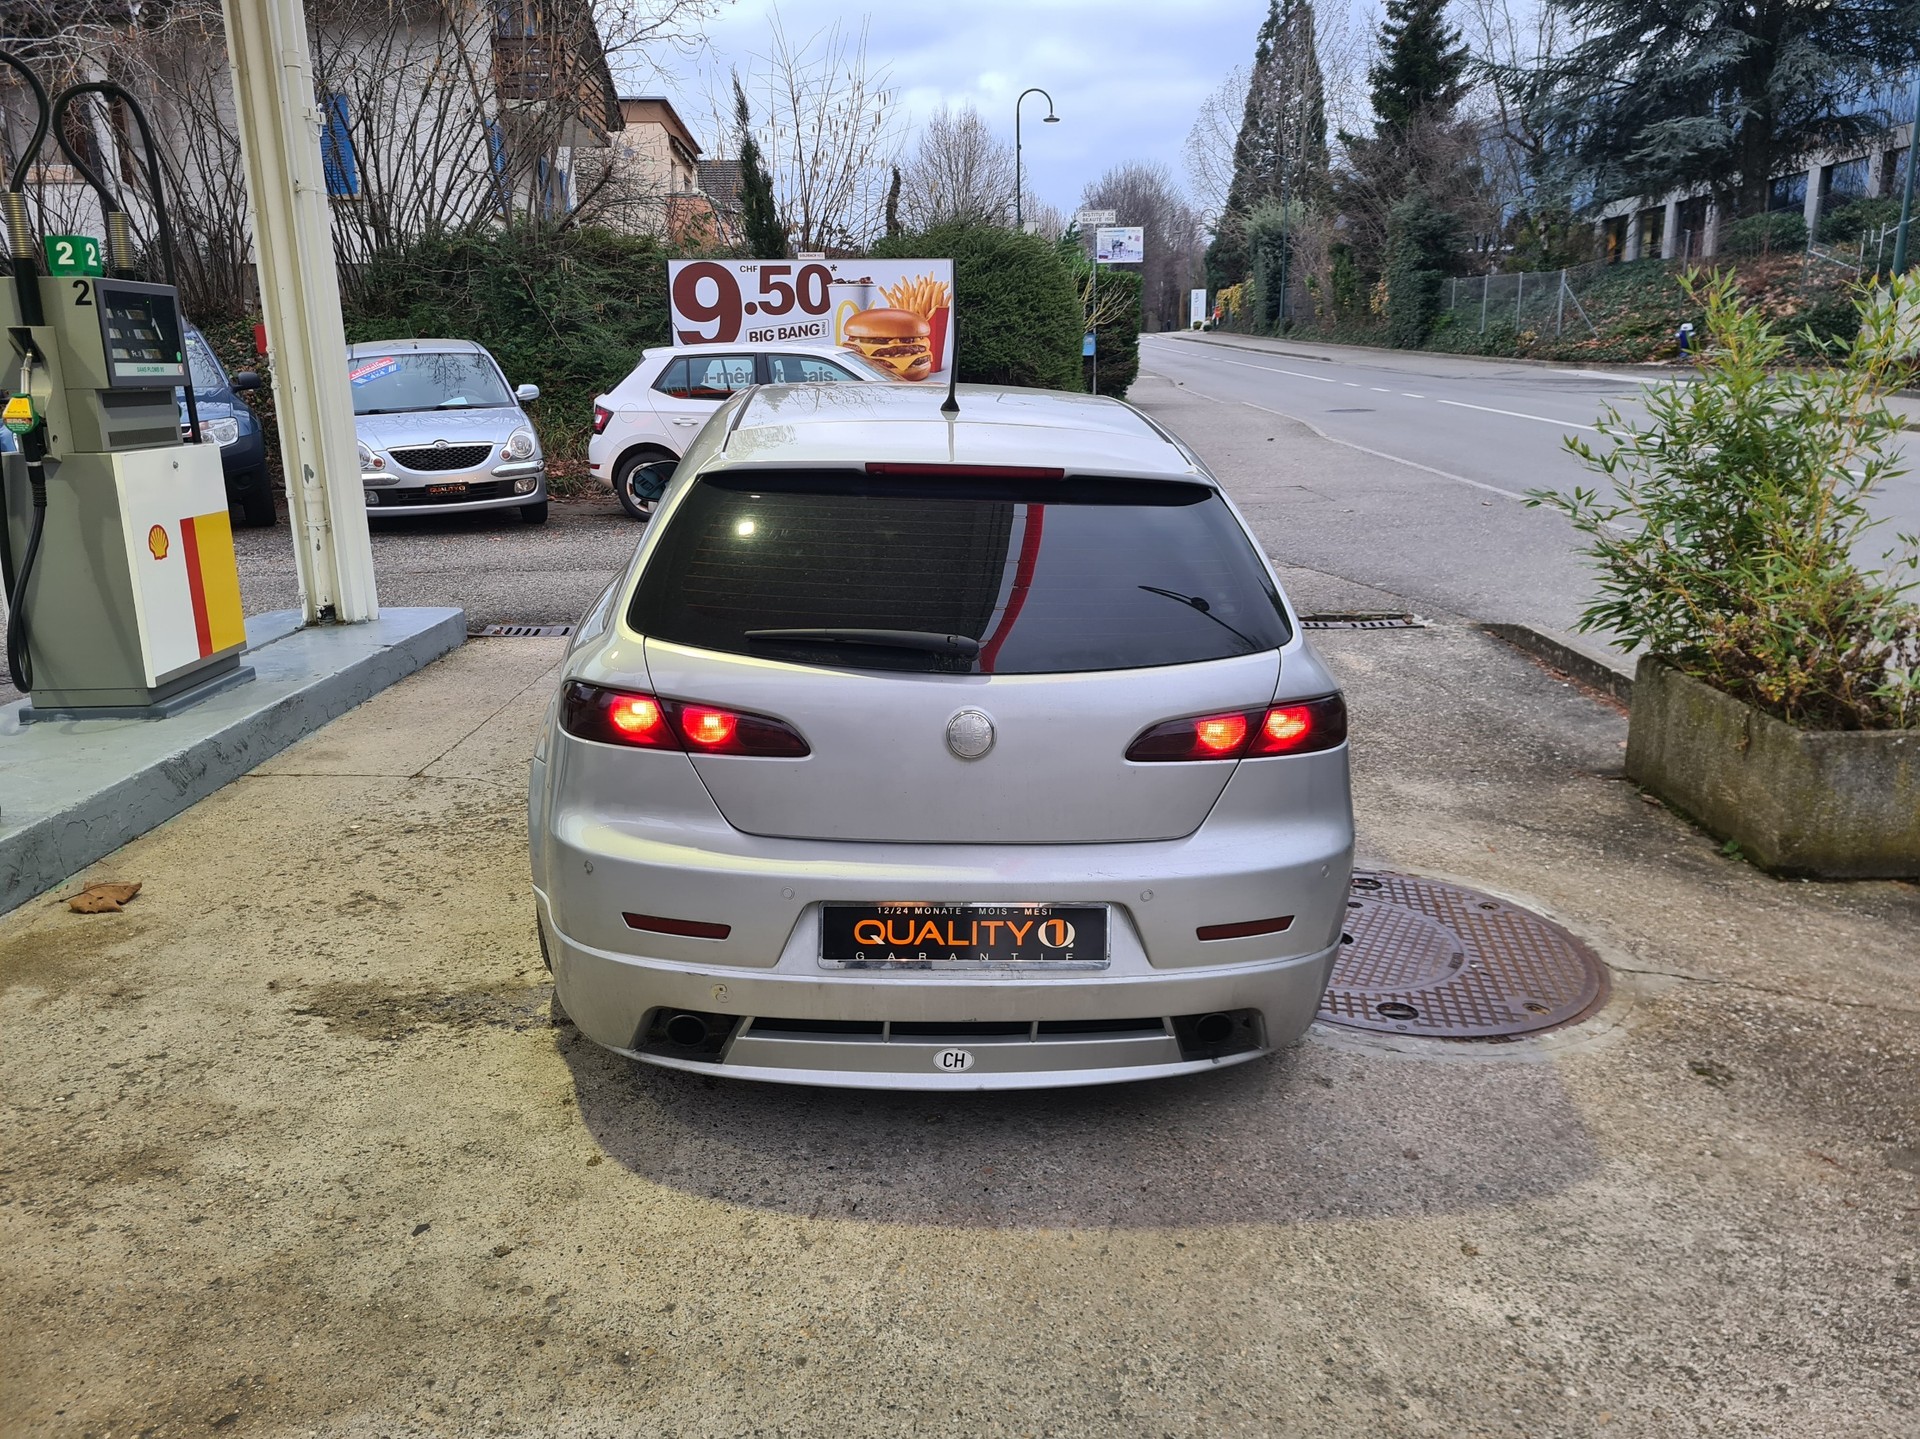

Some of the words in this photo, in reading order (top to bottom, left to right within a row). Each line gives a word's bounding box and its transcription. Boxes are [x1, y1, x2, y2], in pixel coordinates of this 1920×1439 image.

[56, 241, 75, 265] 2
[85, 242, 98, 267] 2
[740, 265, 758, 273] CHF
[72, 279, 93, 306] 2
[749, 329, 775, 342] BIG
[778, 323, 820, 340] BANG
[914, 907, 962, 915] MONATE
[978, 907, 1008, 915] MOIS
[854, 919, 1034, 946] QUALITY
[943, 1052, 965, 1068] CH
